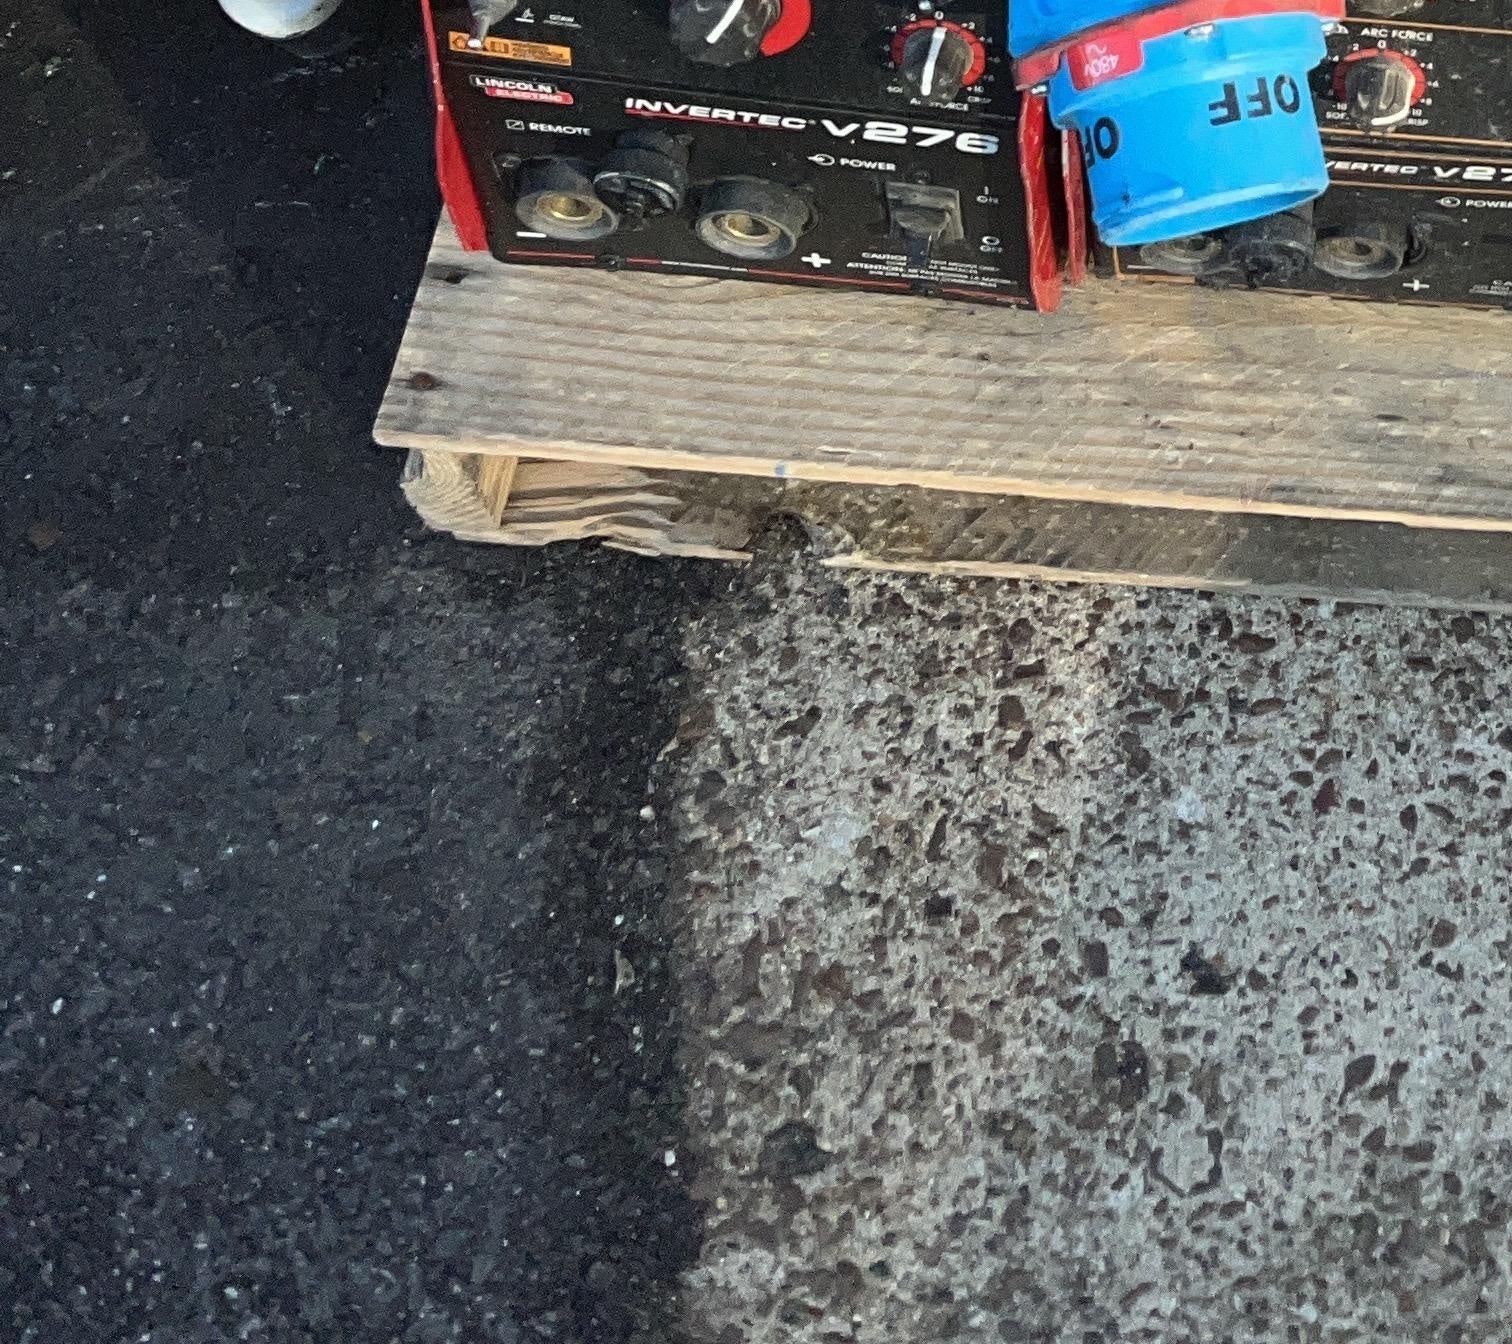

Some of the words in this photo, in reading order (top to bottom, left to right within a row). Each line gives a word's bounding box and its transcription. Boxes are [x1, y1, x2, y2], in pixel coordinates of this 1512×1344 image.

[1360, 27, 1390, 39] ARC
[1391, 27, 1434, 42] FORCE
[475, 76, 552, 94] LINCOLN
[1207, 74, 1302, 127] OFF
[529, 121, 592, 137] REMOTE
[624, 97, 807, 130] INVERTEC
[821, 118, 1001, 155] V276
[1079, 116, 1121, 170] OF
[839, 157, 896, 172] POWER
